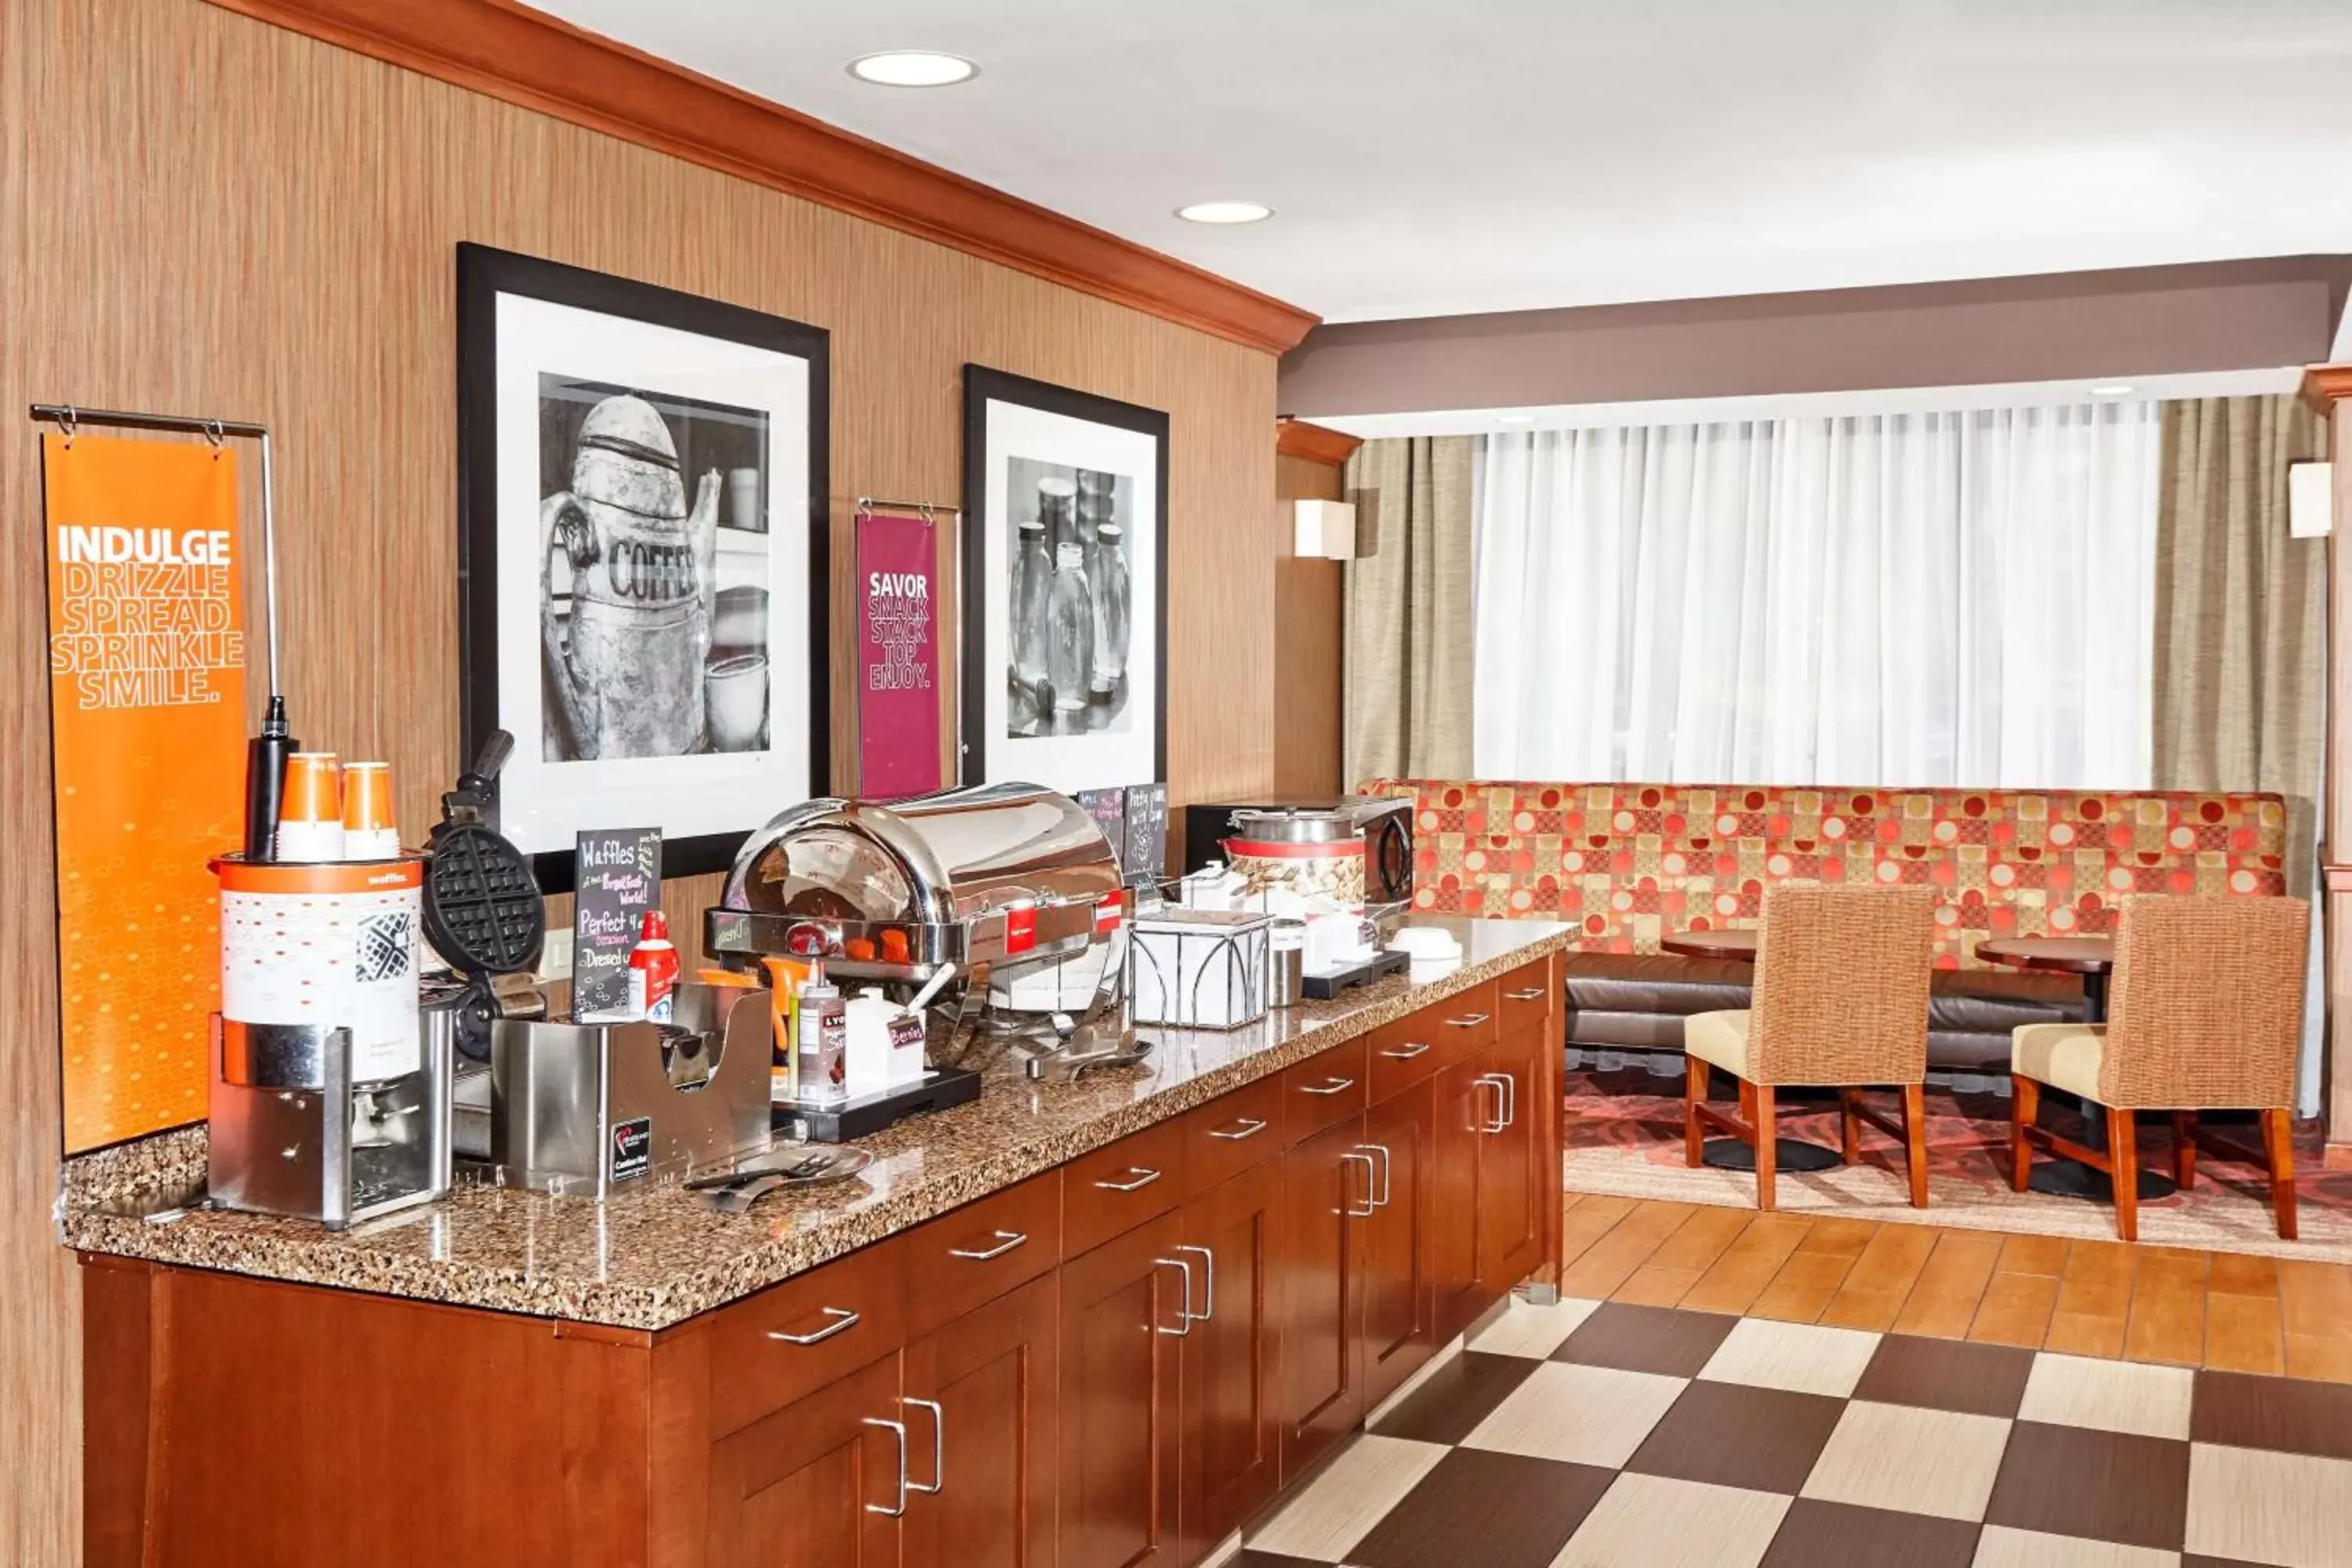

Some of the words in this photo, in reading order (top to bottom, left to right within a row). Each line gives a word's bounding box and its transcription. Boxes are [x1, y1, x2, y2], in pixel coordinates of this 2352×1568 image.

[59, 525, 230, 564] INDULGE
[63, 561, 230, 599] DRIZZLE
[608, 539, 695, 601] COFFEE
[869, 572, 927, 597] SAVOR
[63, 597, 230, 634] SPREAD
[869, 596, 929, 619] SNACK
[871, 619, 927, 643] STACK
[51, 631, 244, 674] SPRINKLE
[883, 641, 916, 666] TOP
[78, 667, 220, 710] SMILE.
[869, 663, 931, 690] ENJOY.
[582, 840, 634, 868] Waffles
[580, 909, 626, 935] Perfect
[583, 948, 622, 967] Dressed
